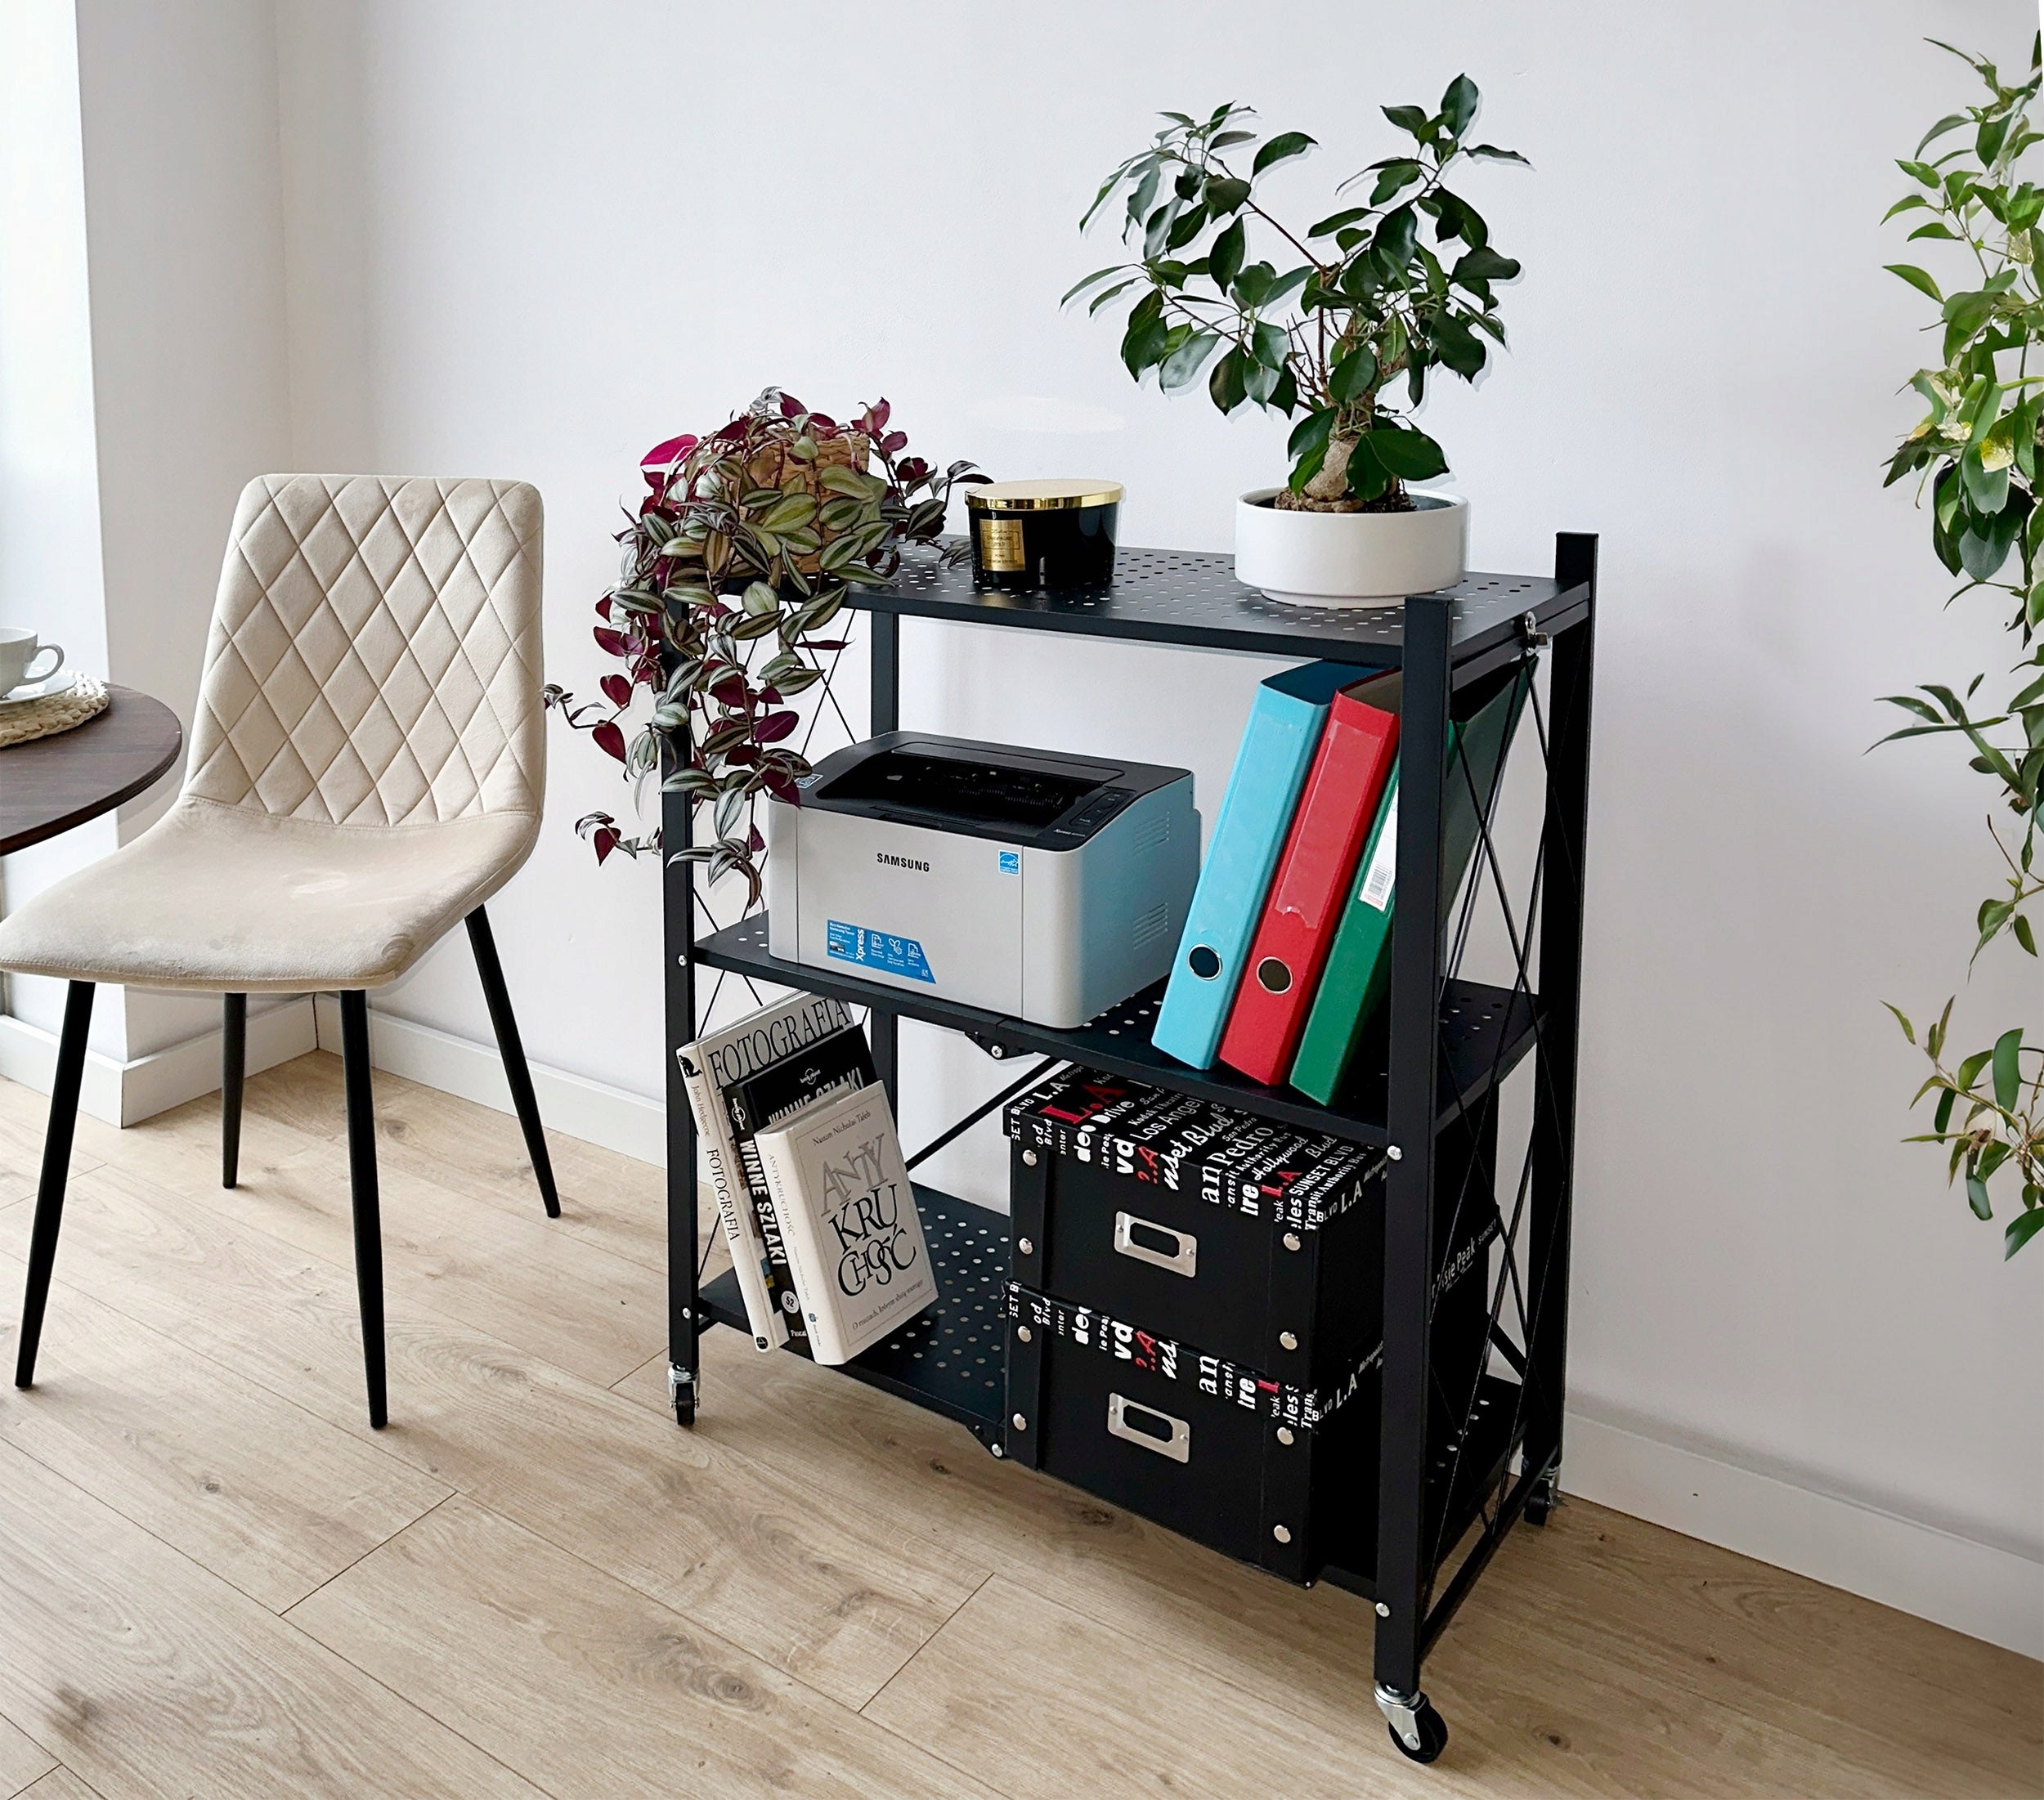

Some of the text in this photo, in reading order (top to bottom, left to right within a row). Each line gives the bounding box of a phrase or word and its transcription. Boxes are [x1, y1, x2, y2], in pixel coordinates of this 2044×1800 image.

[876, 853, 930, 872] SAMSUNG
[855, 928, 866, 961] Xpress
[708, 998, 851, 1090] FOTOGRAFIA
[691, 1085, 702, 1107] John
[1011, 1098, 1035, 1117] BLVD
[1032, 1081, 1071, 1101] L.A
[1038, 1083, 1127, 1125] L.A
[1090, 1100, 1136, 1125] Drive
[1043, 1118, 1053, 1145] Blvd
[1127, 1109, 1159, 1126] Kodak
[1129, 1122, 1167, 1141] Los
[1158, 1096, 1204, 1126] Angel
[1221, 1117, 1258, 1142] San Pedro
[1206, 1126, 1275, 1166] Pedro
[1251, 1135, 1309, 1181] Hollywood
[821, 1133, 889, 1217] ANTY
[1225, 1170, 1240, 1208] ansit
[1235, 1142, 1279, 1172] Authority
[1261, 1170, 1303, 1198] L.A
[1286, 1145, 1355, 1229] les SUNSET BLVD
[706, 1148, 740, 1241] FOTOGRAFIA
[739, 1140, 787, 1265] WINNE SZLAKI
[1341, 1180, 1363, 1214] L.A
[828, 1184, 897, 1256] KRU
[838, 1223, 917, 1296] CHOŚĆ
[1456, 1237, 1475, 1271] Peak
[1042, 1296, 1051, 1326] Blvd
[1336, 1372, 1358, 1409] L.A
[1282, 1394, 1299, 1426] les
